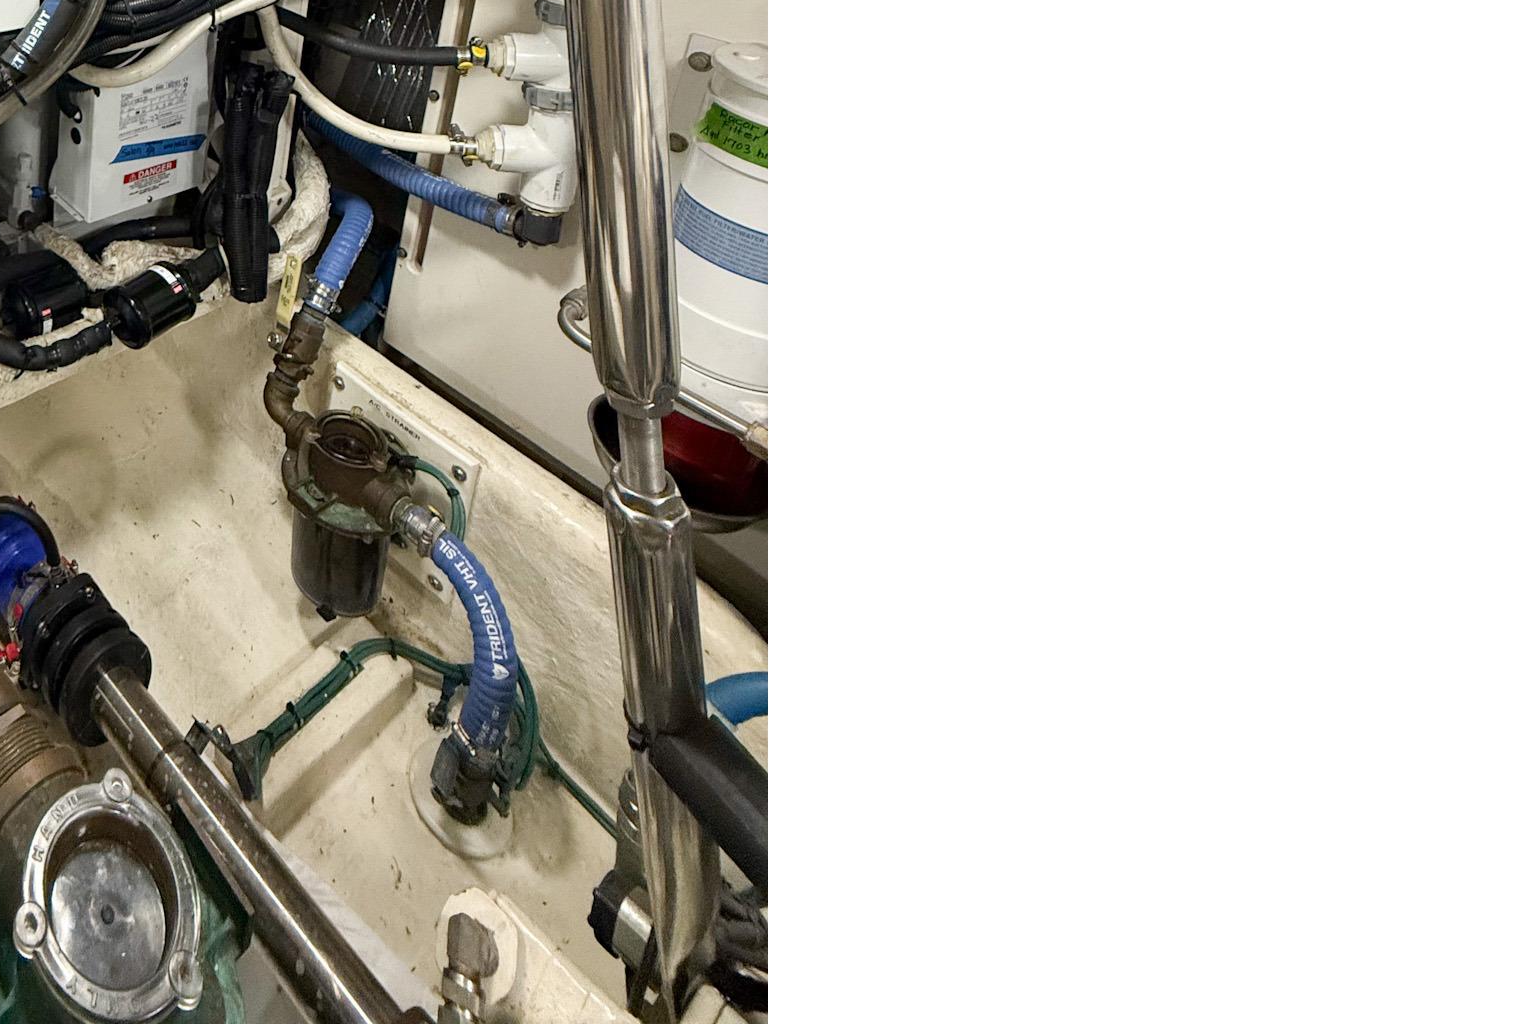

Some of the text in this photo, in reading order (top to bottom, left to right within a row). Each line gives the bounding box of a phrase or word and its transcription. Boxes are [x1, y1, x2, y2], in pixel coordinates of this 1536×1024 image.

[137, 162, 173, 179] DANGER
[385, 411, 421, 441] STRAINER
[438, 538, 458, 560] SIL
[454, 562, 478, 591] VHT
[473, 592, 504, 661] TRIDENT
